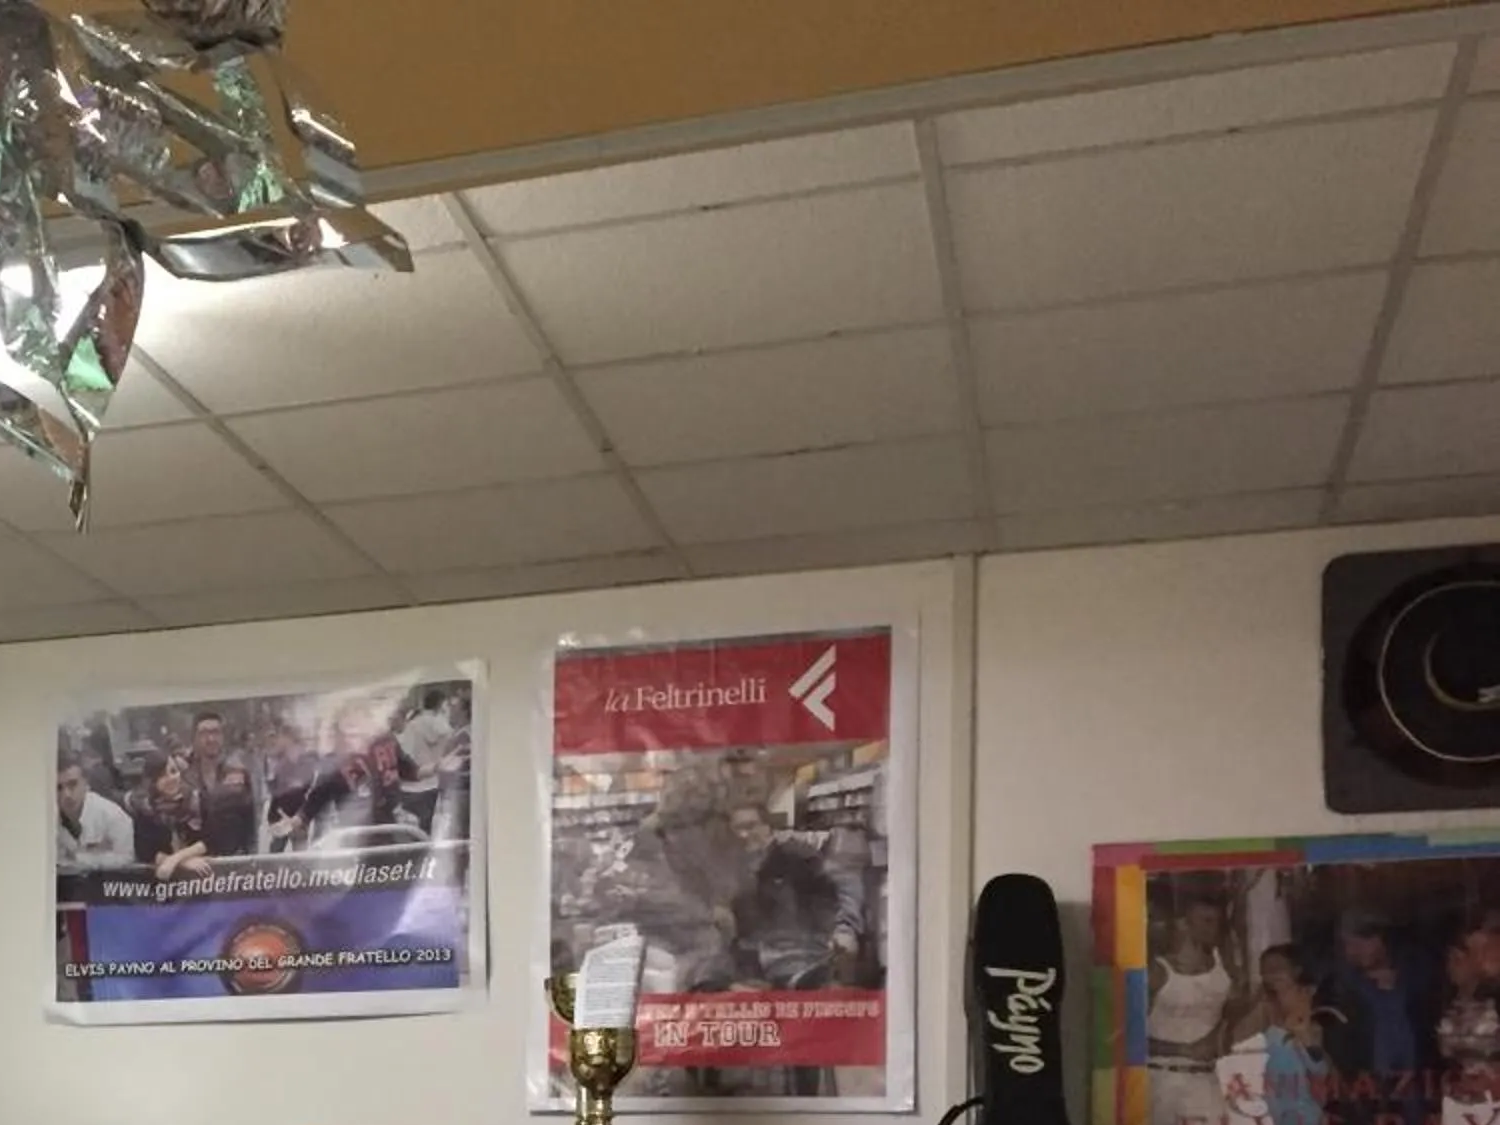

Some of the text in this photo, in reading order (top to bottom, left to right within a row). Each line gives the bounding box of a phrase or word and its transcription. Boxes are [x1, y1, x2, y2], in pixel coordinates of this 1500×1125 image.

[634, 677, 768, 711] Feltrinelli
[102, 857, 436, 901] www.grandefratello.mediaset.it
[65, 948, 451, 977] ELVIS PAYNO AL PROVINO DEL GRANDE FRATELLO 2013
[654, 1019, 781, 1047] IN TOUR
